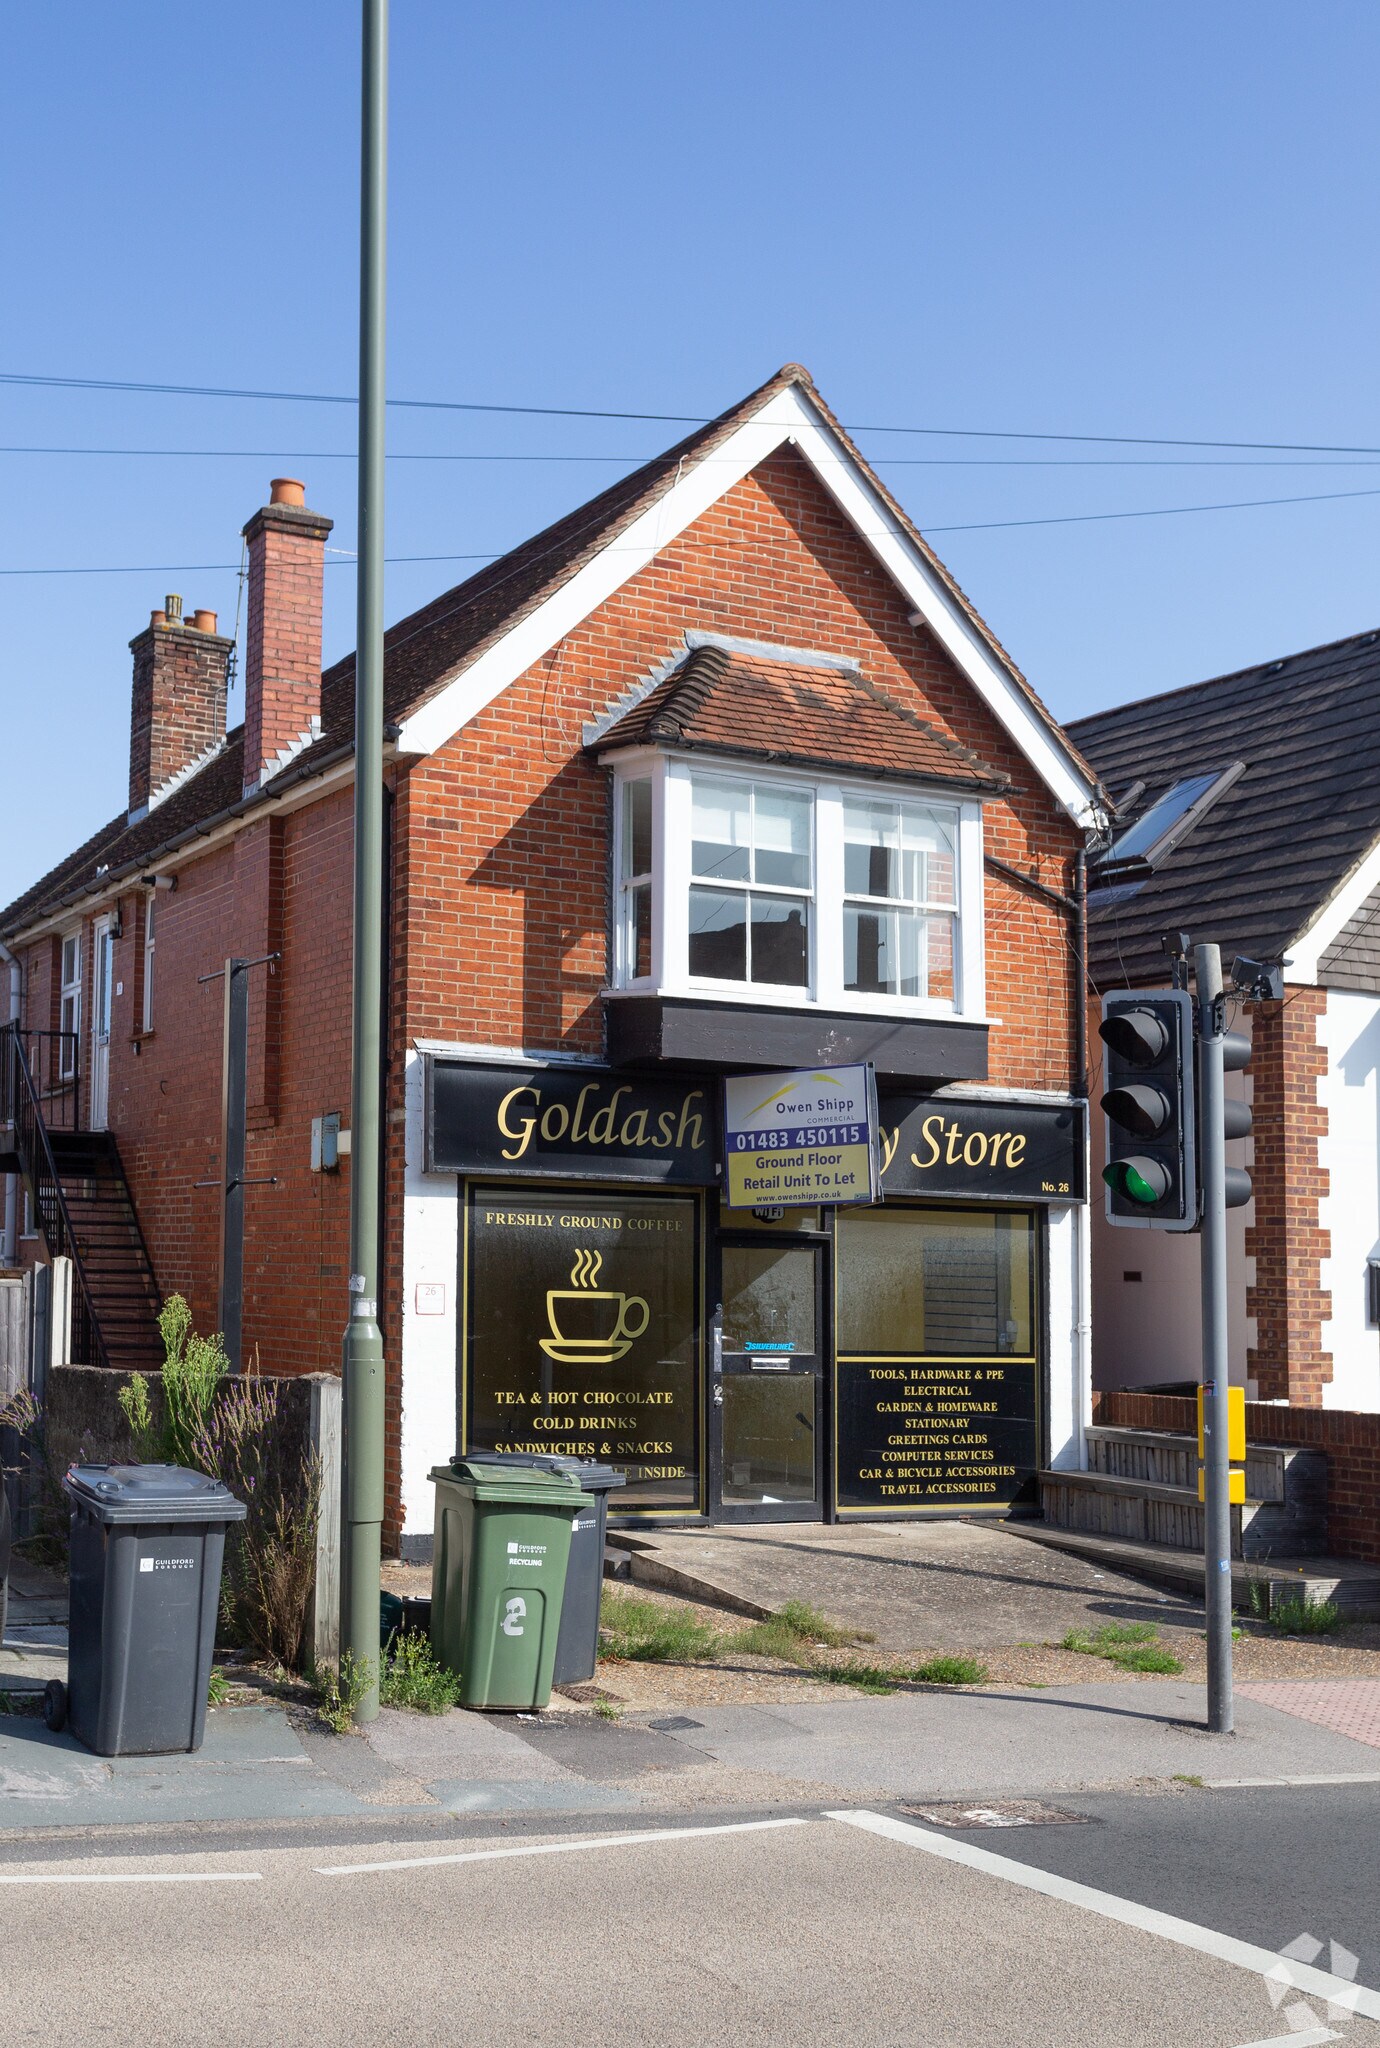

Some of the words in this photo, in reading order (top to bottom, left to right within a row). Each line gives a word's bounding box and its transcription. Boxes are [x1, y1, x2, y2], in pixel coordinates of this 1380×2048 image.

[776, 1101, 812, 1114] Owen
[817, 1098, 854, 1112] Shipp
[497, 1083, 705, 1160] Goldash
[806, 1115, 855, 1124] COMMERCIAL
[736, 1131, 789, 1150] 01483
[795, 1126, 860, 1146] 450115
[911, 1116, 1026, 1168] Store
[755, 1154, 804, 1169] Ground
[808, 1153, 842, 1166] Floor
[744, 1176, 780, 1190] Retail
[784, 1174, 811, 1188] Unit
[815, 1174, 831, 1185] To
[834, 1172, 856, 1184] Let
[1042, 1182, 1056, 1192] No.
[1058, 1183, 1070, 1193] 26
[756, 1191, 842, 1203] www.owenshipp.co.uk
[485, 1212, 555, 1227] FRESHLY
[559, 1215, 622, 1229] GROUND
[627, 1218, 683, 1231] COFFEE
[870, 1369, 908, 1381] TOOLS,
[910, 1370, 971, 1380] HARDWARE
[974, 1370, 983, 1380] &
[986, 1370, 1004, 1380] PPE
[903, 1386, 972, 1396] ELECTRICAL
[494, 1392, 526, 1404] TEA
[530, 1392, 543, 1404] &
[547, 1392, 579, 1404] HOT
[583, 1392, 673, 1404] CHOCOLATE
[876, 1403, 922, 1413] GARDEN
[925, 1402, 934, 1412] &
[937, 1402, 998, 1412] HOMEWARE
[533, 1417, 575, 1430] COLD
[579, 1417, 637, 1430] DRINKS
[905, 1418, 970, 1429] STATIONARY
[888, 1434, 949, 1445] GREETINGS
[952, 1434, 987, 1444] CARDS
[494, 1442, 595, 1454] SANDWICHES
[600, 1442, 612, 1454] &
[616, 1441, 673, 1454] SNACKS
[882, 1451, 941, 1462] COMPUTER
[944, 1450, 994, 1461] SERVICES
[638, 1466, 686, 1479] INSIDE
[859, 1468, 882, 1479] CAR
[885, 1468, 894, 1478] &
[897, 1467, 942, 1478] BICYCLE
[945, 1466, 1016, 1476] ACCESSORIES
[880, 1484, 923, 1495] TRAVEL
[926, 1482, 996, 1494] ACCESSORIES
[509, 1558, 543, 1567] RECYCLING
